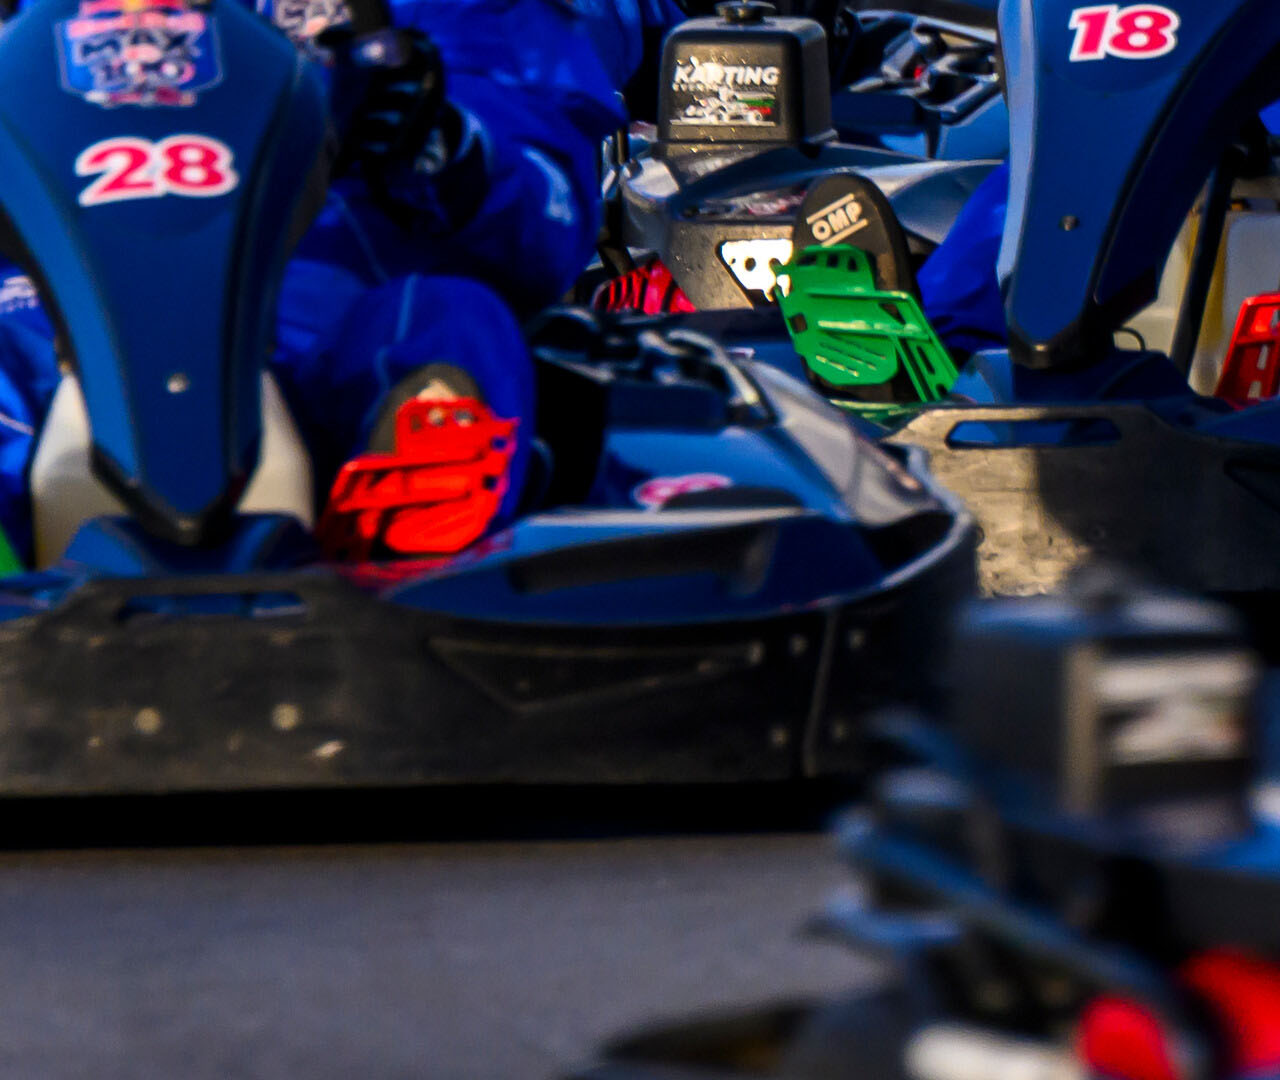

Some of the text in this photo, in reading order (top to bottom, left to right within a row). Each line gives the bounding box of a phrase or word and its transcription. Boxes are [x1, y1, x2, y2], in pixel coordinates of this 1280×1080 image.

[1068, 3, 1181, 63] 18
[674, 64, 780, 86] KARTING
[74, 133, 239, 207] 28
[812, 201, 862, 241] OMP
